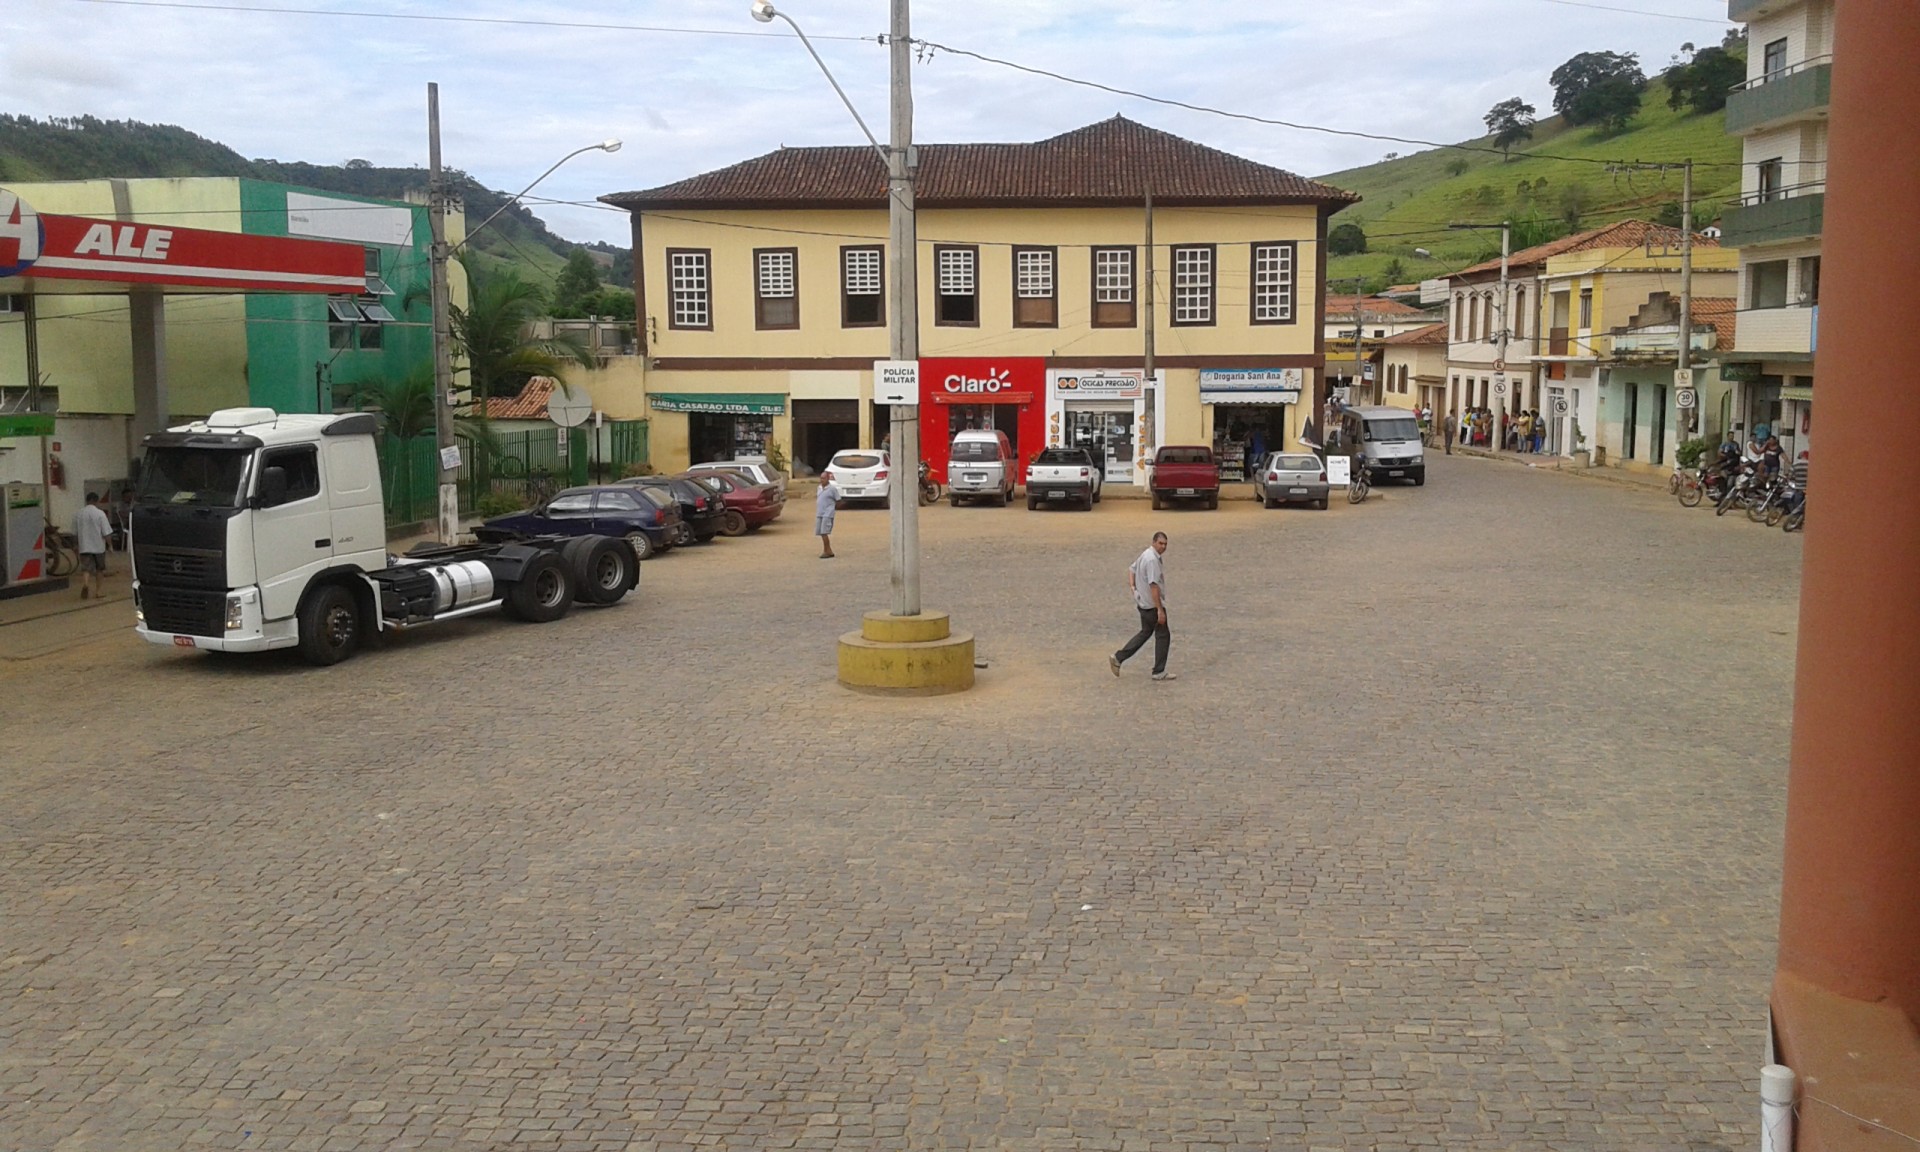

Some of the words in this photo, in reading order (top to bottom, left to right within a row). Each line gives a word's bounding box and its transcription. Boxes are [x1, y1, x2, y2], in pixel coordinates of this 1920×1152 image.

[74, 223, 173, 260] ALE
[883, 368, 915, 376] POLÍCIA
[1213, 372, 1245, 382] Drogaria
[944, 373, 1002, 393] Claro
[725, 404, 749, 412] LTDA
